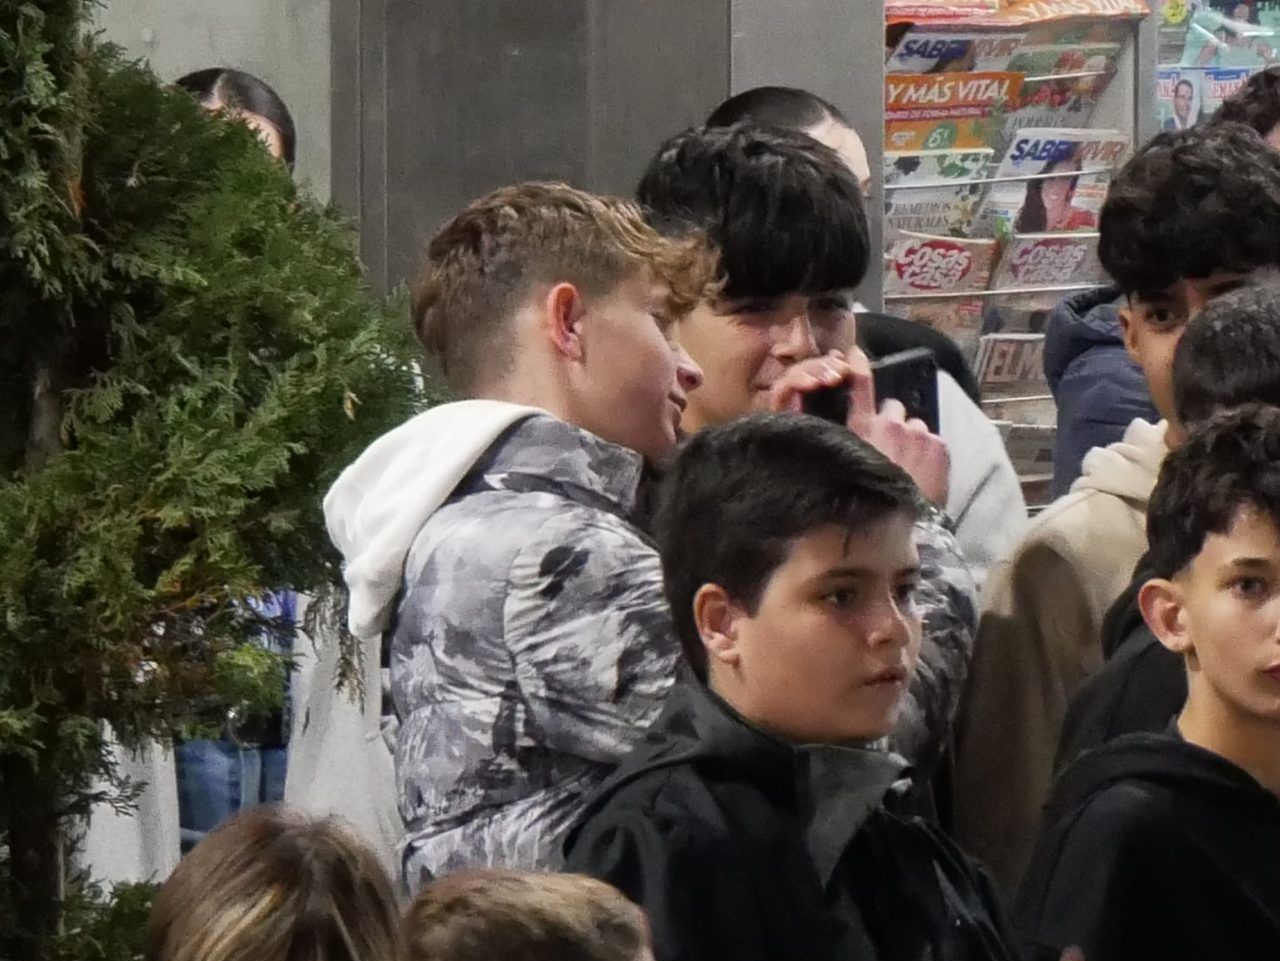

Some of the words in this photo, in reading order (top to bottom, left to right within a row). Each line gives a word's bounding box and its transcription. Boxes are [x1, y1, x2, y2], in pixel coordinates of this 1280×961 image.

[887, 84, 905, 105] Y
[903, 76, 955, 104] MÁS
[958, 79, 1010, 101] VITAL
